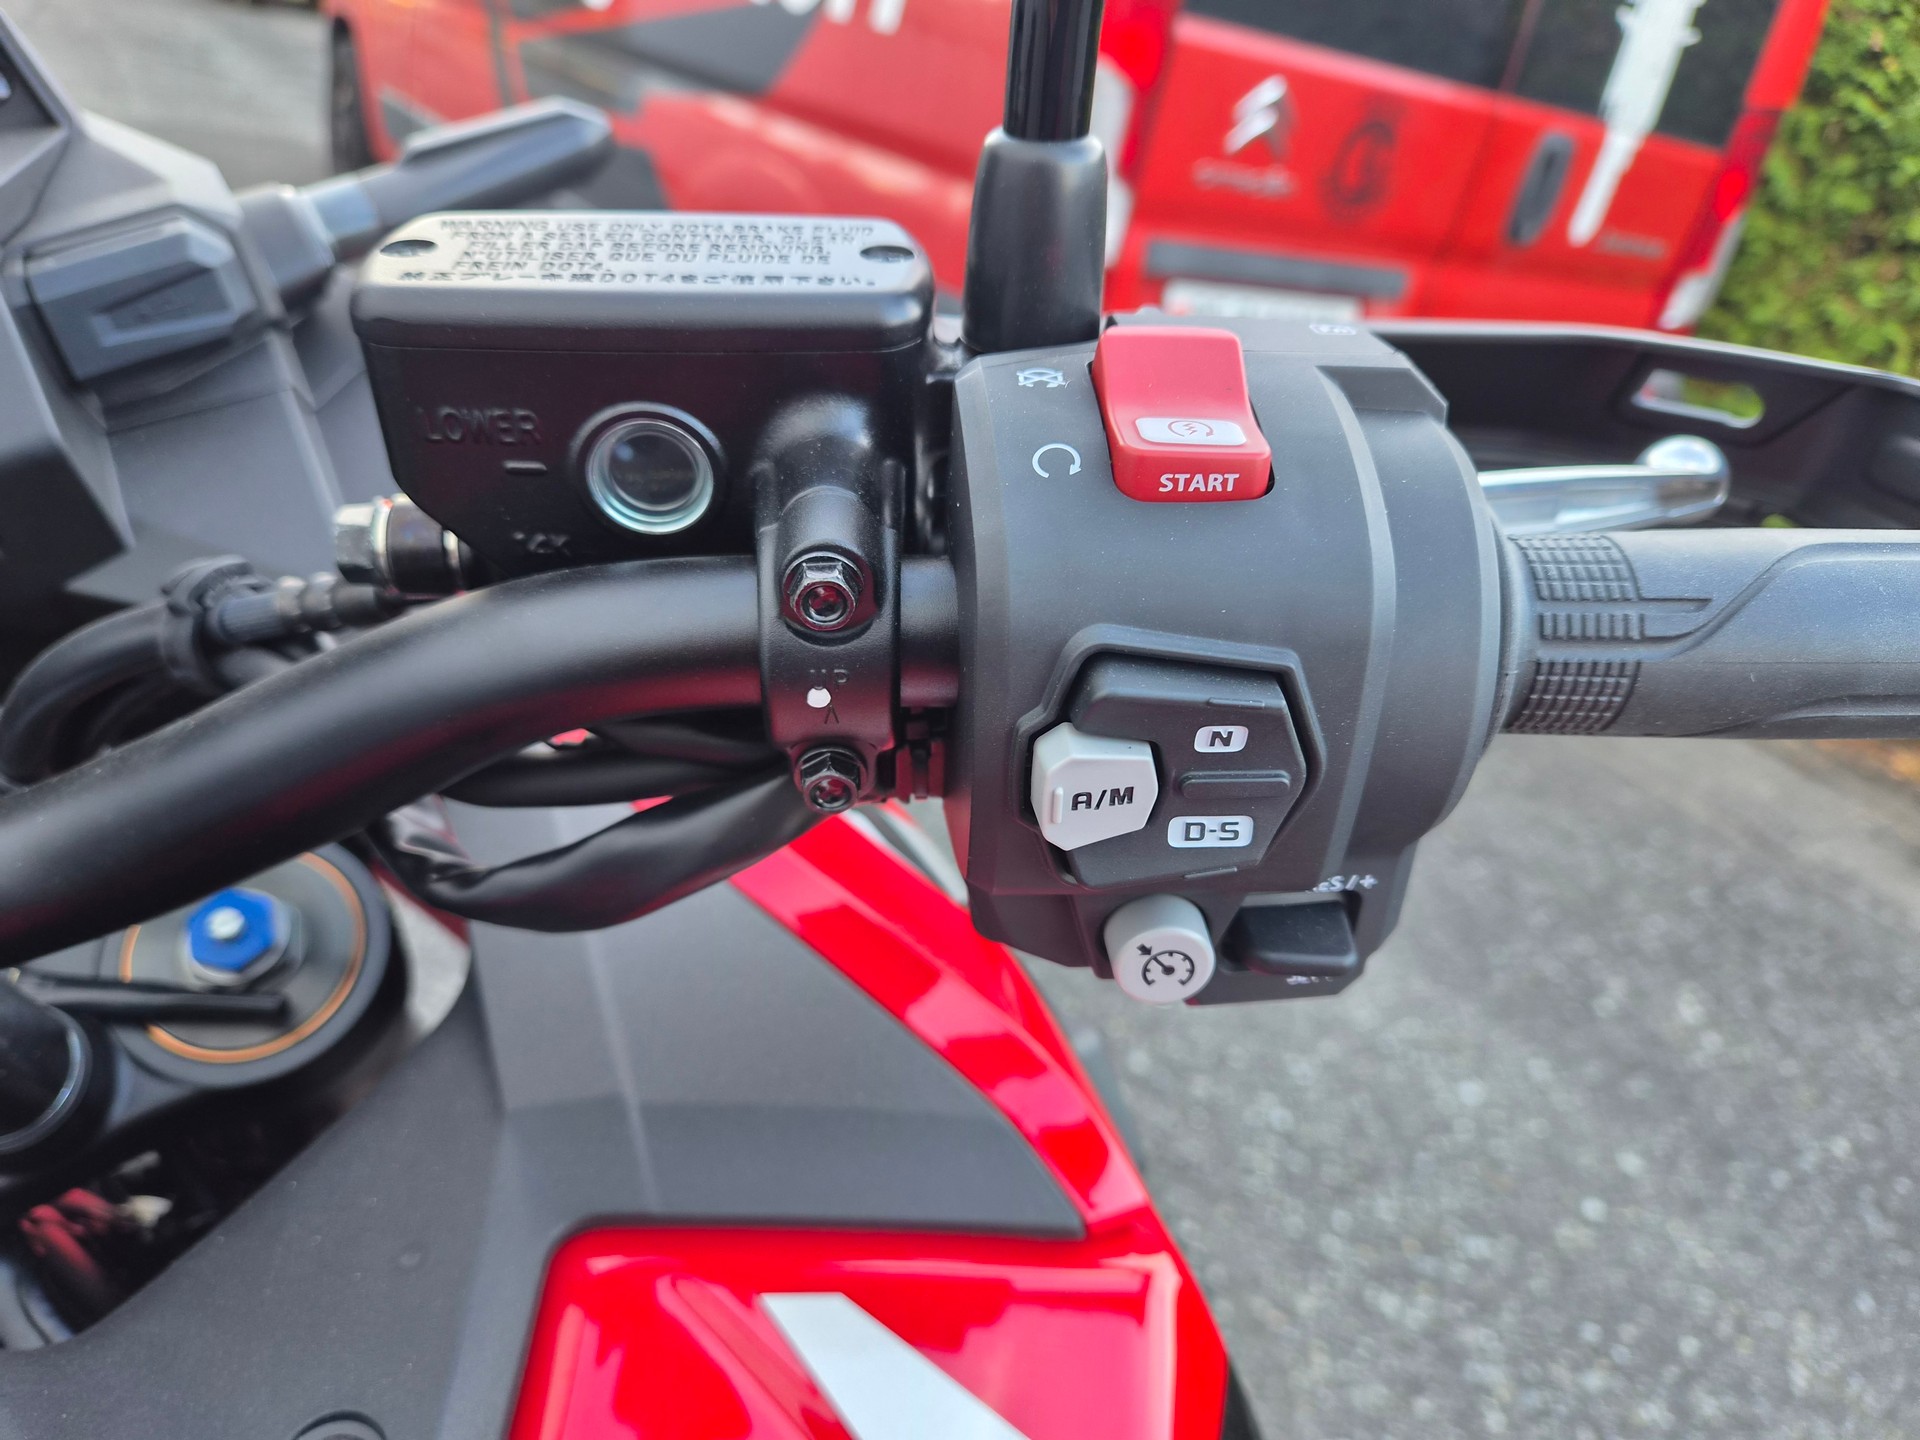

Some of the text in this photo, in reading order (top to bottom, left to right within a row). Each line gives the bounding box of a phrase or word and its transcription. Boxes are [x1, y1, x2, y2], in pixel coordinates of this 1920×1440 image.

[440, 220, 873, 237] WARNING USE ONLY DOT4 BRAKE FLUID
[451, 231, 514, 241] FROM
[523, 231, 534, 241] A
[543, 232, 633, 242] SEALED
[782, 235, 856, 245] CLEAN
[469, 241, 550, 251] FILLER
[558, 242, 603, 251] CAP
[610, 242, 700, 253] BEFORE
[451, 261, 528, 271] FREIN
[608, 251, 655, 262] QUE
[666, 252, 698, 263] DU
[706, 253, 791, 264] FLUIDE
[801, 254, 831, 264] DE
[420, 406, 543, 443] LOWER
[1158, 473, 1240, 493] START
[1209, 730, 1234, 747] N
[1071, 786, 1135, 811] A/M
[1184, 821, 1240, 842] D-S
